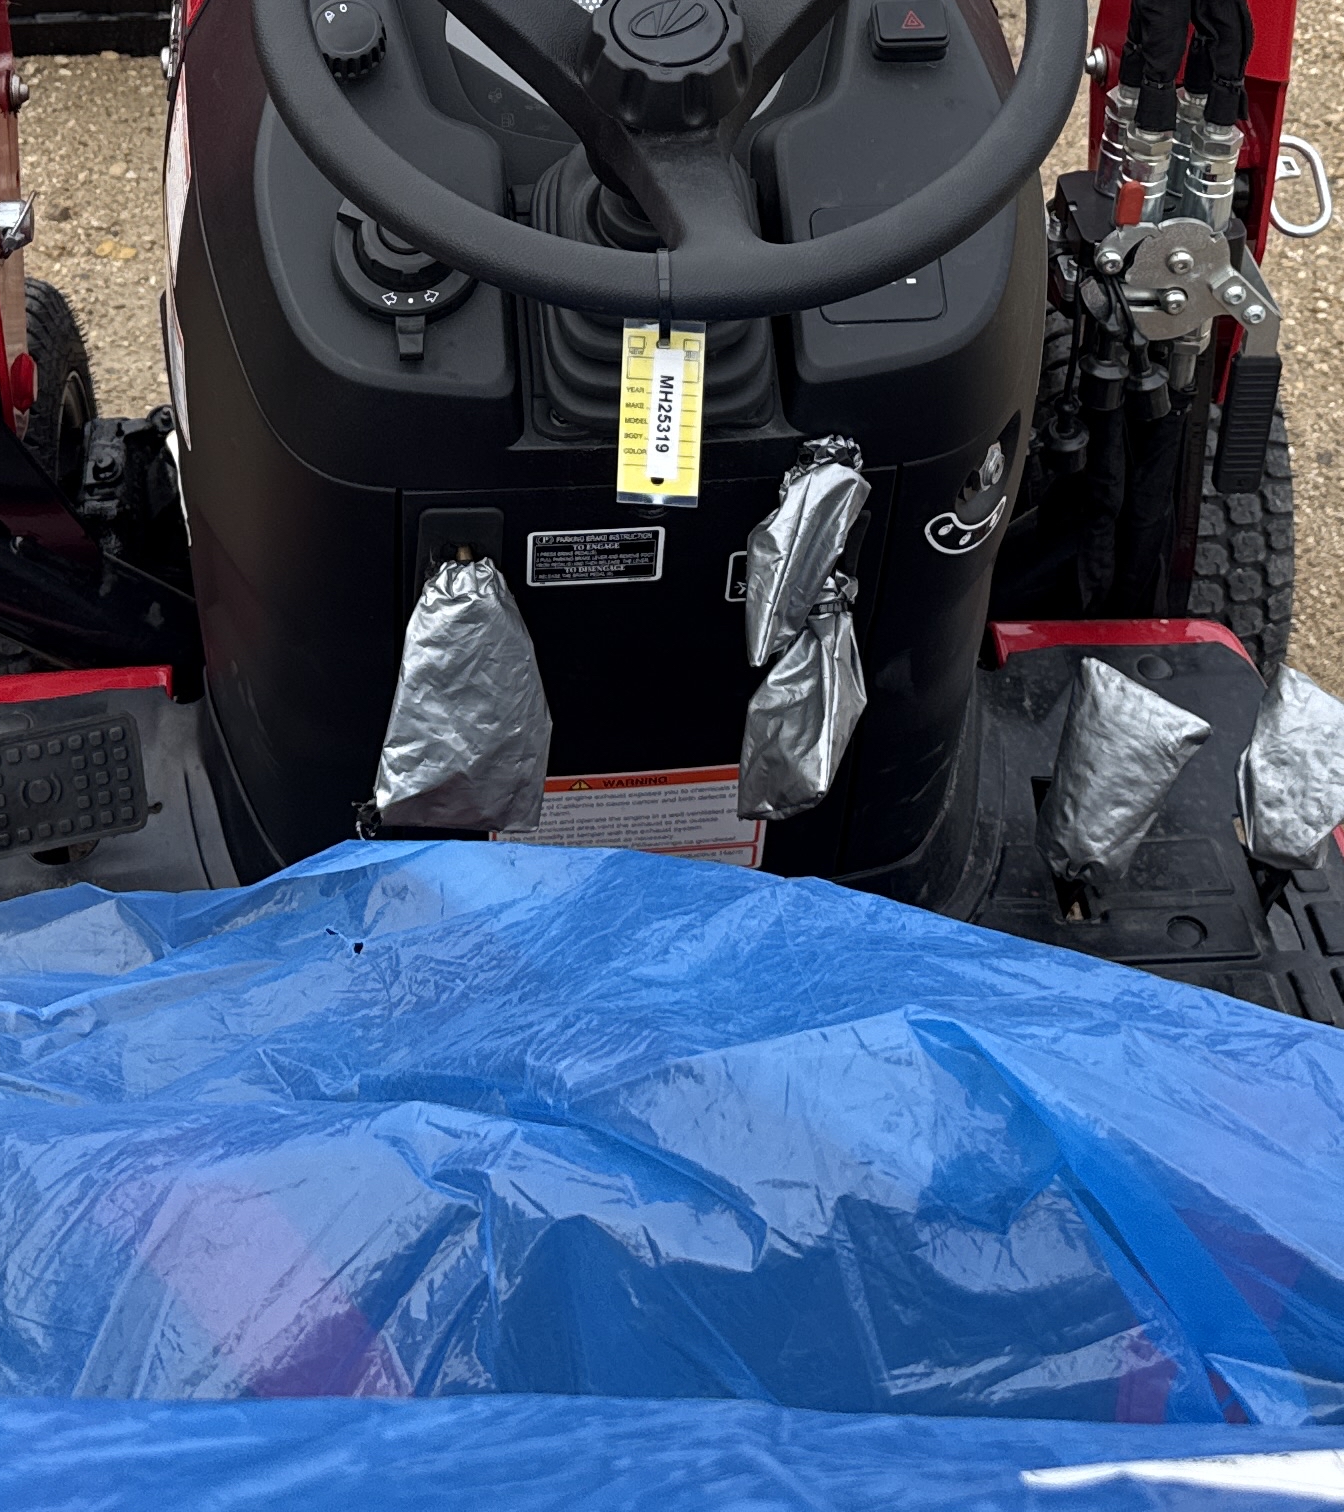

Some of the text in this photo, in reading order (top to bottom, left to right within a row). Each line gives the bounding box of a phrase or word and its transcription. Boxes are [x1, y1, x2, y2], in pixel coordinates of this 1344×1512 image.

[626, 386, 645, 394] YEAR
[655, 374, 675, 454] MH25319
[623, 447, 647, 455] COLOR
[587, 542, 620, 550] ENGAGE
[578, 565, 625, 573] DISENGAGE
[602, 775, 668, 788] WARNING
[565, 794, 592, 802] engine
[594, 792, 626, 800] exhaust
[576, 816, 607, 824] operate
